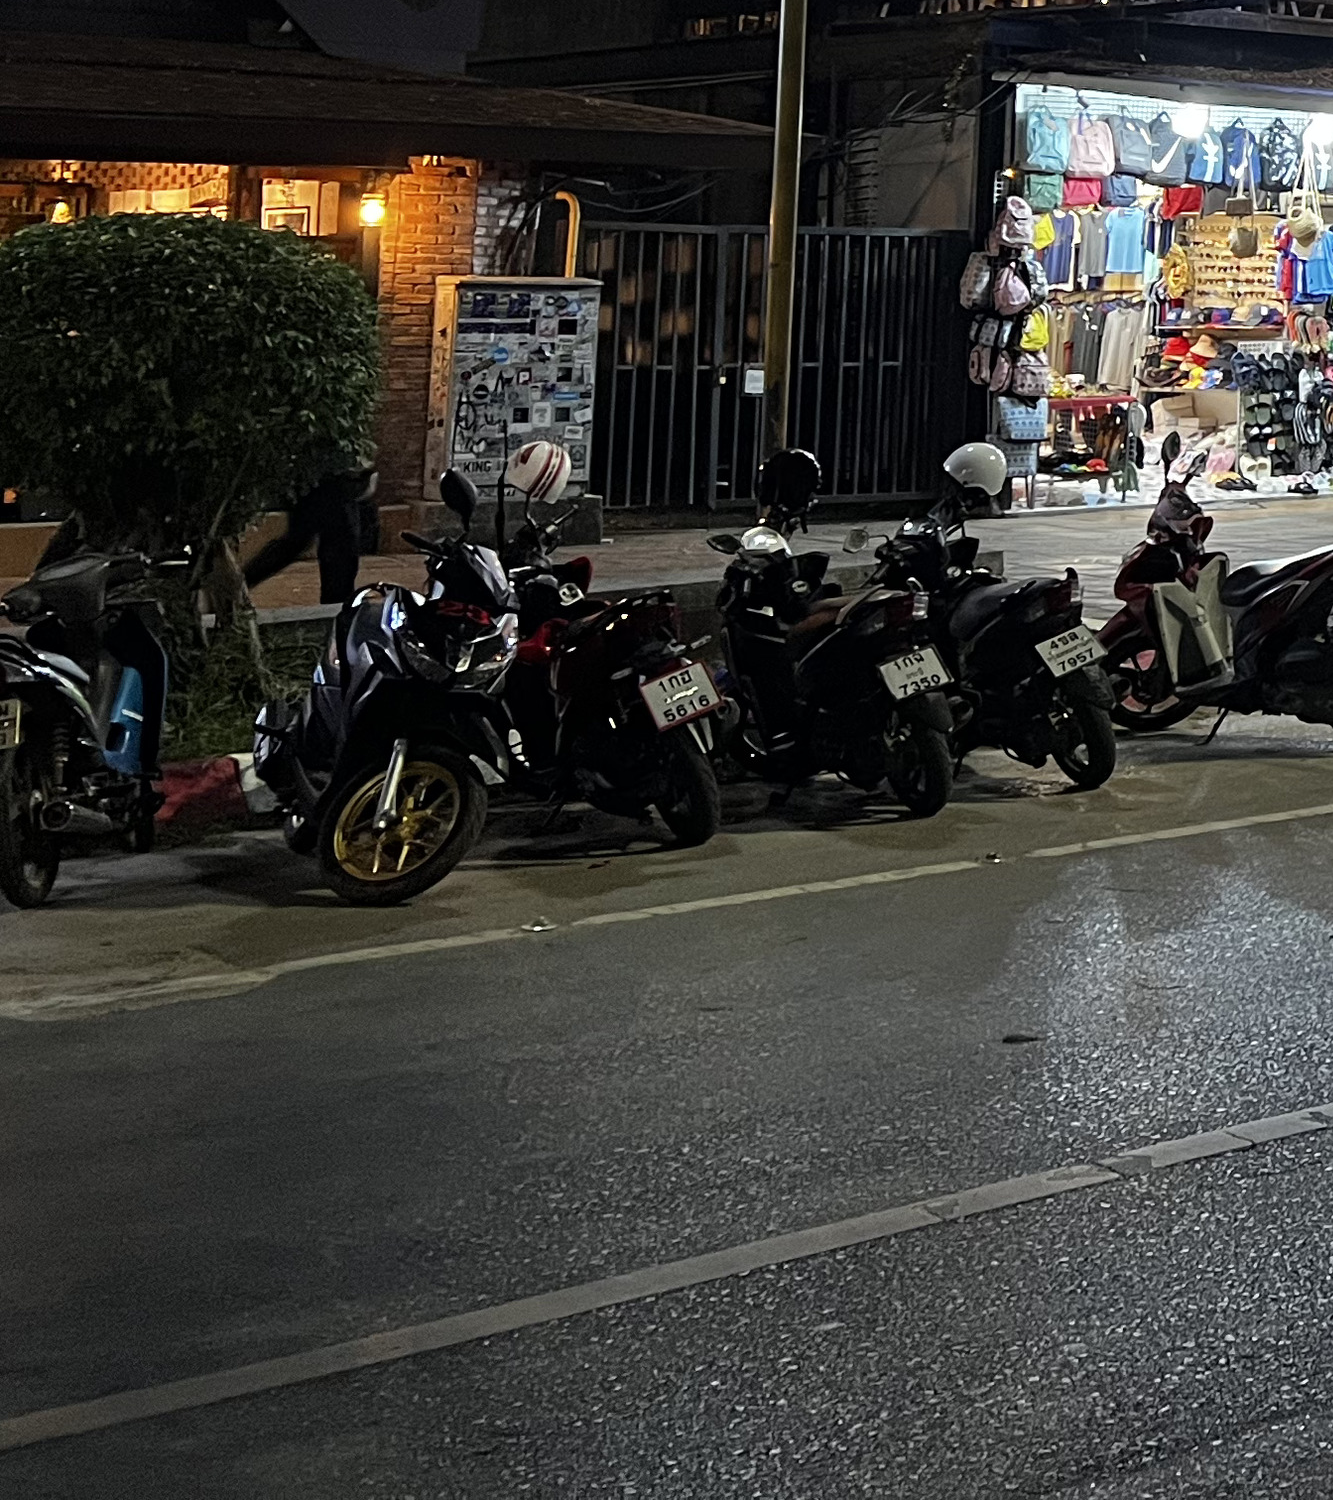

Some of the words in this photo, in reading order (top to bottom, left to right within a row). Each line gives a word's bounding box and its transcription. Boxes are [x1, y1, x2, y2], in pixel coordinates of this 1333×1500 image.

[463, 460, 491, 473] KING
[1056, 647, 1094, 672] 7957
[898, 674, 941, 696] 7350
[663, 694, 710, 723] 5616
